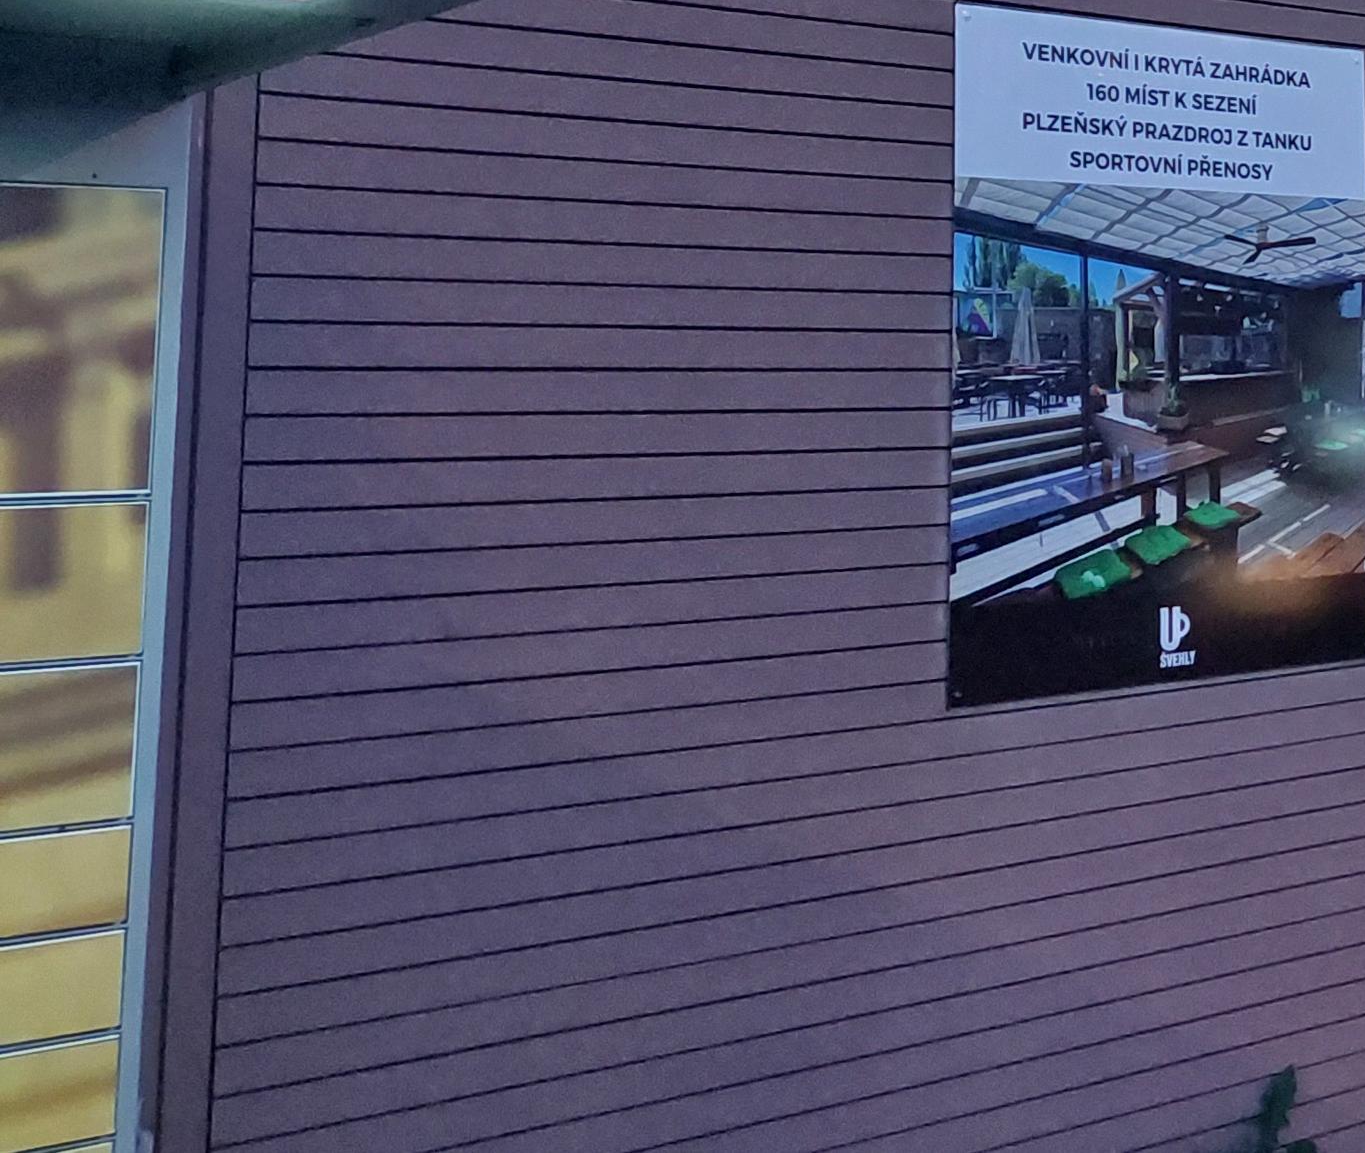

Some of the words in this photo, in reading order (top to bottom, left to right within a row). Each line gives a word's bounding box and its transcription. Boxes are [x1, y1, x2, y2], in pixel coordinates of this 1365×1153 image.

[1022, 42, 1130, 70] VENKOVNÍ
[1134, 53, 1140, 71] I
[1144, 54, 1206, 78] KRYTÁ
[1209, 62, 1311, 88] ZAHRÁDKA
[1086, 83, 1120, 102] 160
[1125, 84, 1170, 107] MÍST
[1174, 91, 1188, 109] K
[1191, 93, 1258, 115] SEZENÍ
[1022, 110, 1128, 137] PLZEŇSKÝ
[1132, 121, 1233, 145] PRAZDROJ
[1236, 130, 1249, 147] Z
[1252, 131, 1312, 151] TANKU
[1069, 150, 1183, 175] SPORTOVNÍ
[1187, 155, 1273, 181] PŘENOSY
